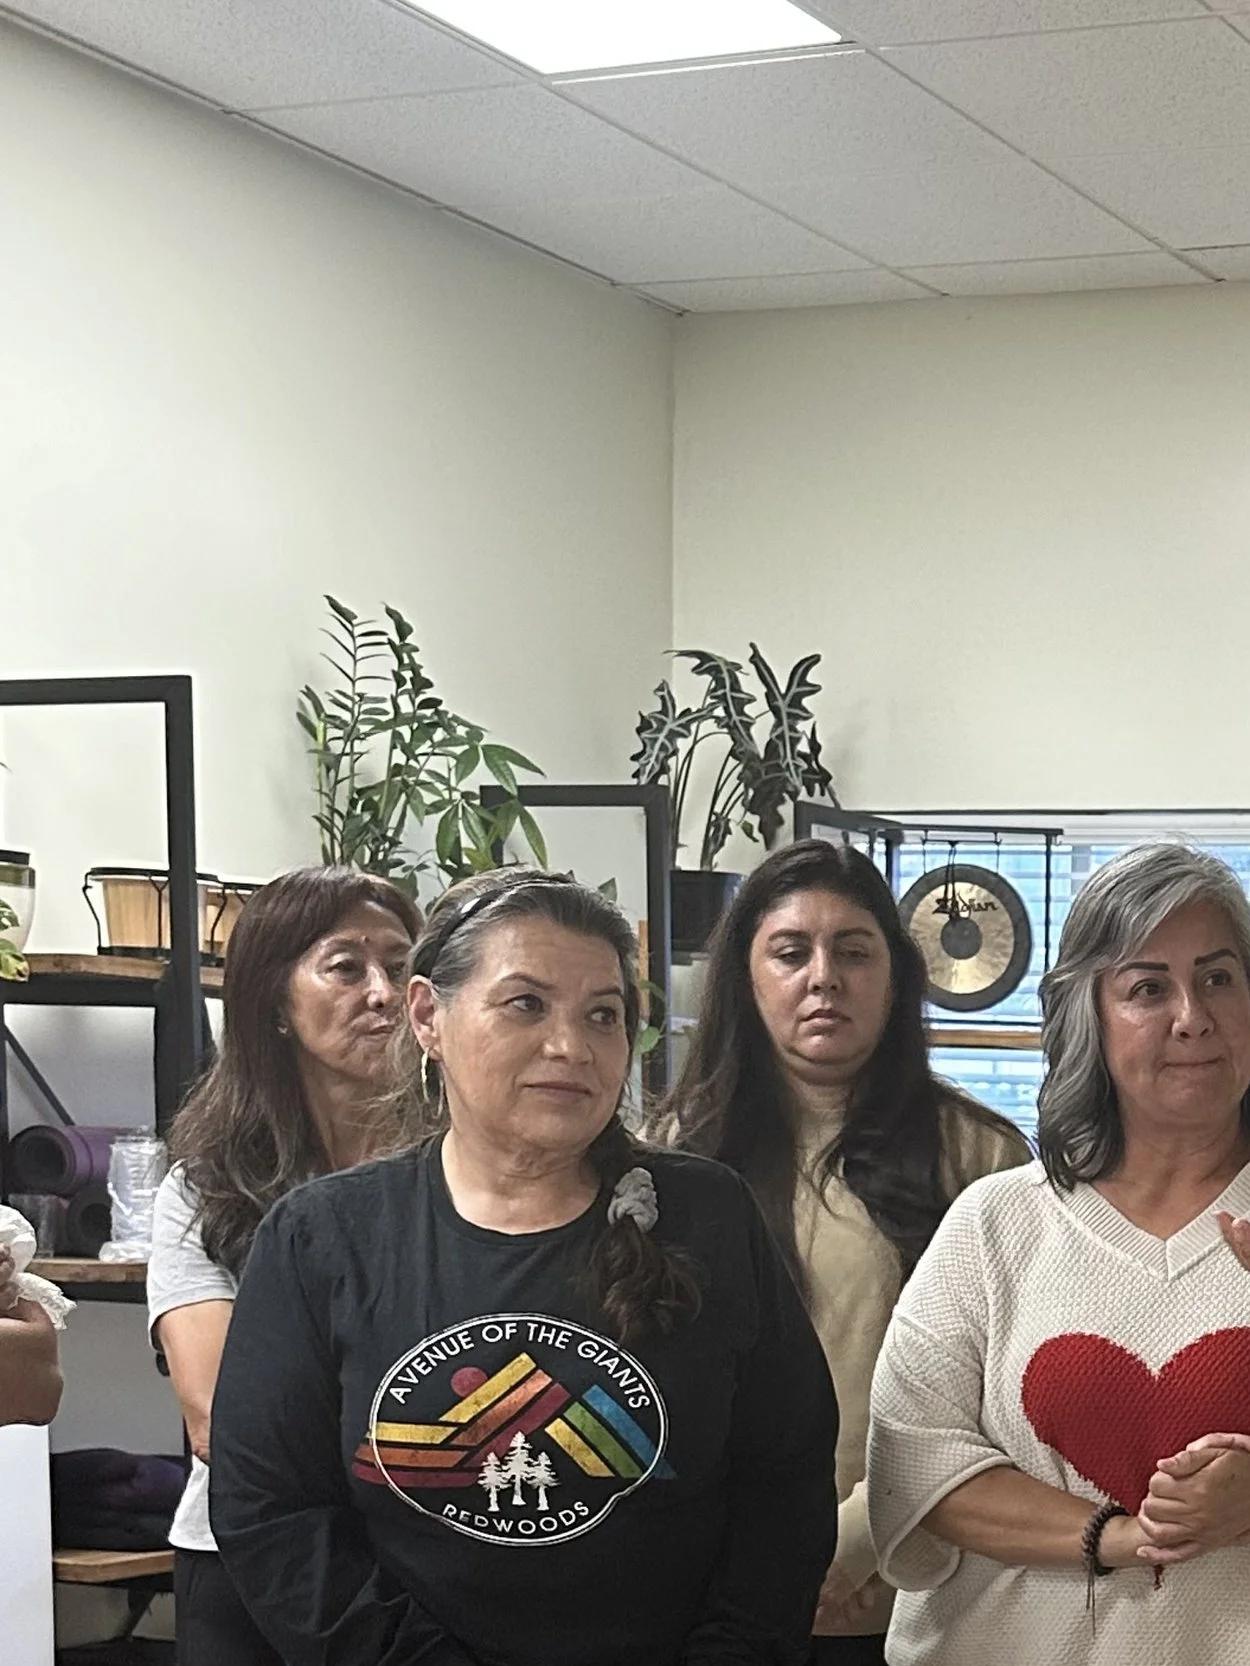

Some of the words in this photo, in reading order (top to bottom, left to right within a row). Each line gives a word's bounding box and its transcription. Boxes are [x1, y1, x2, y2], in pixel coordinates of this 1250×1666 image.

[933, 892, 998, 919] Zdjian
[389, 1330, 474, 1404] AVENUE
[481, 1323, 519, 1343] OF
[527, 1323, 573, 1349] THE
[577, 1339, 650, 1409] GIANTS
[442, 1501, 589, 1534] REDWOODS
